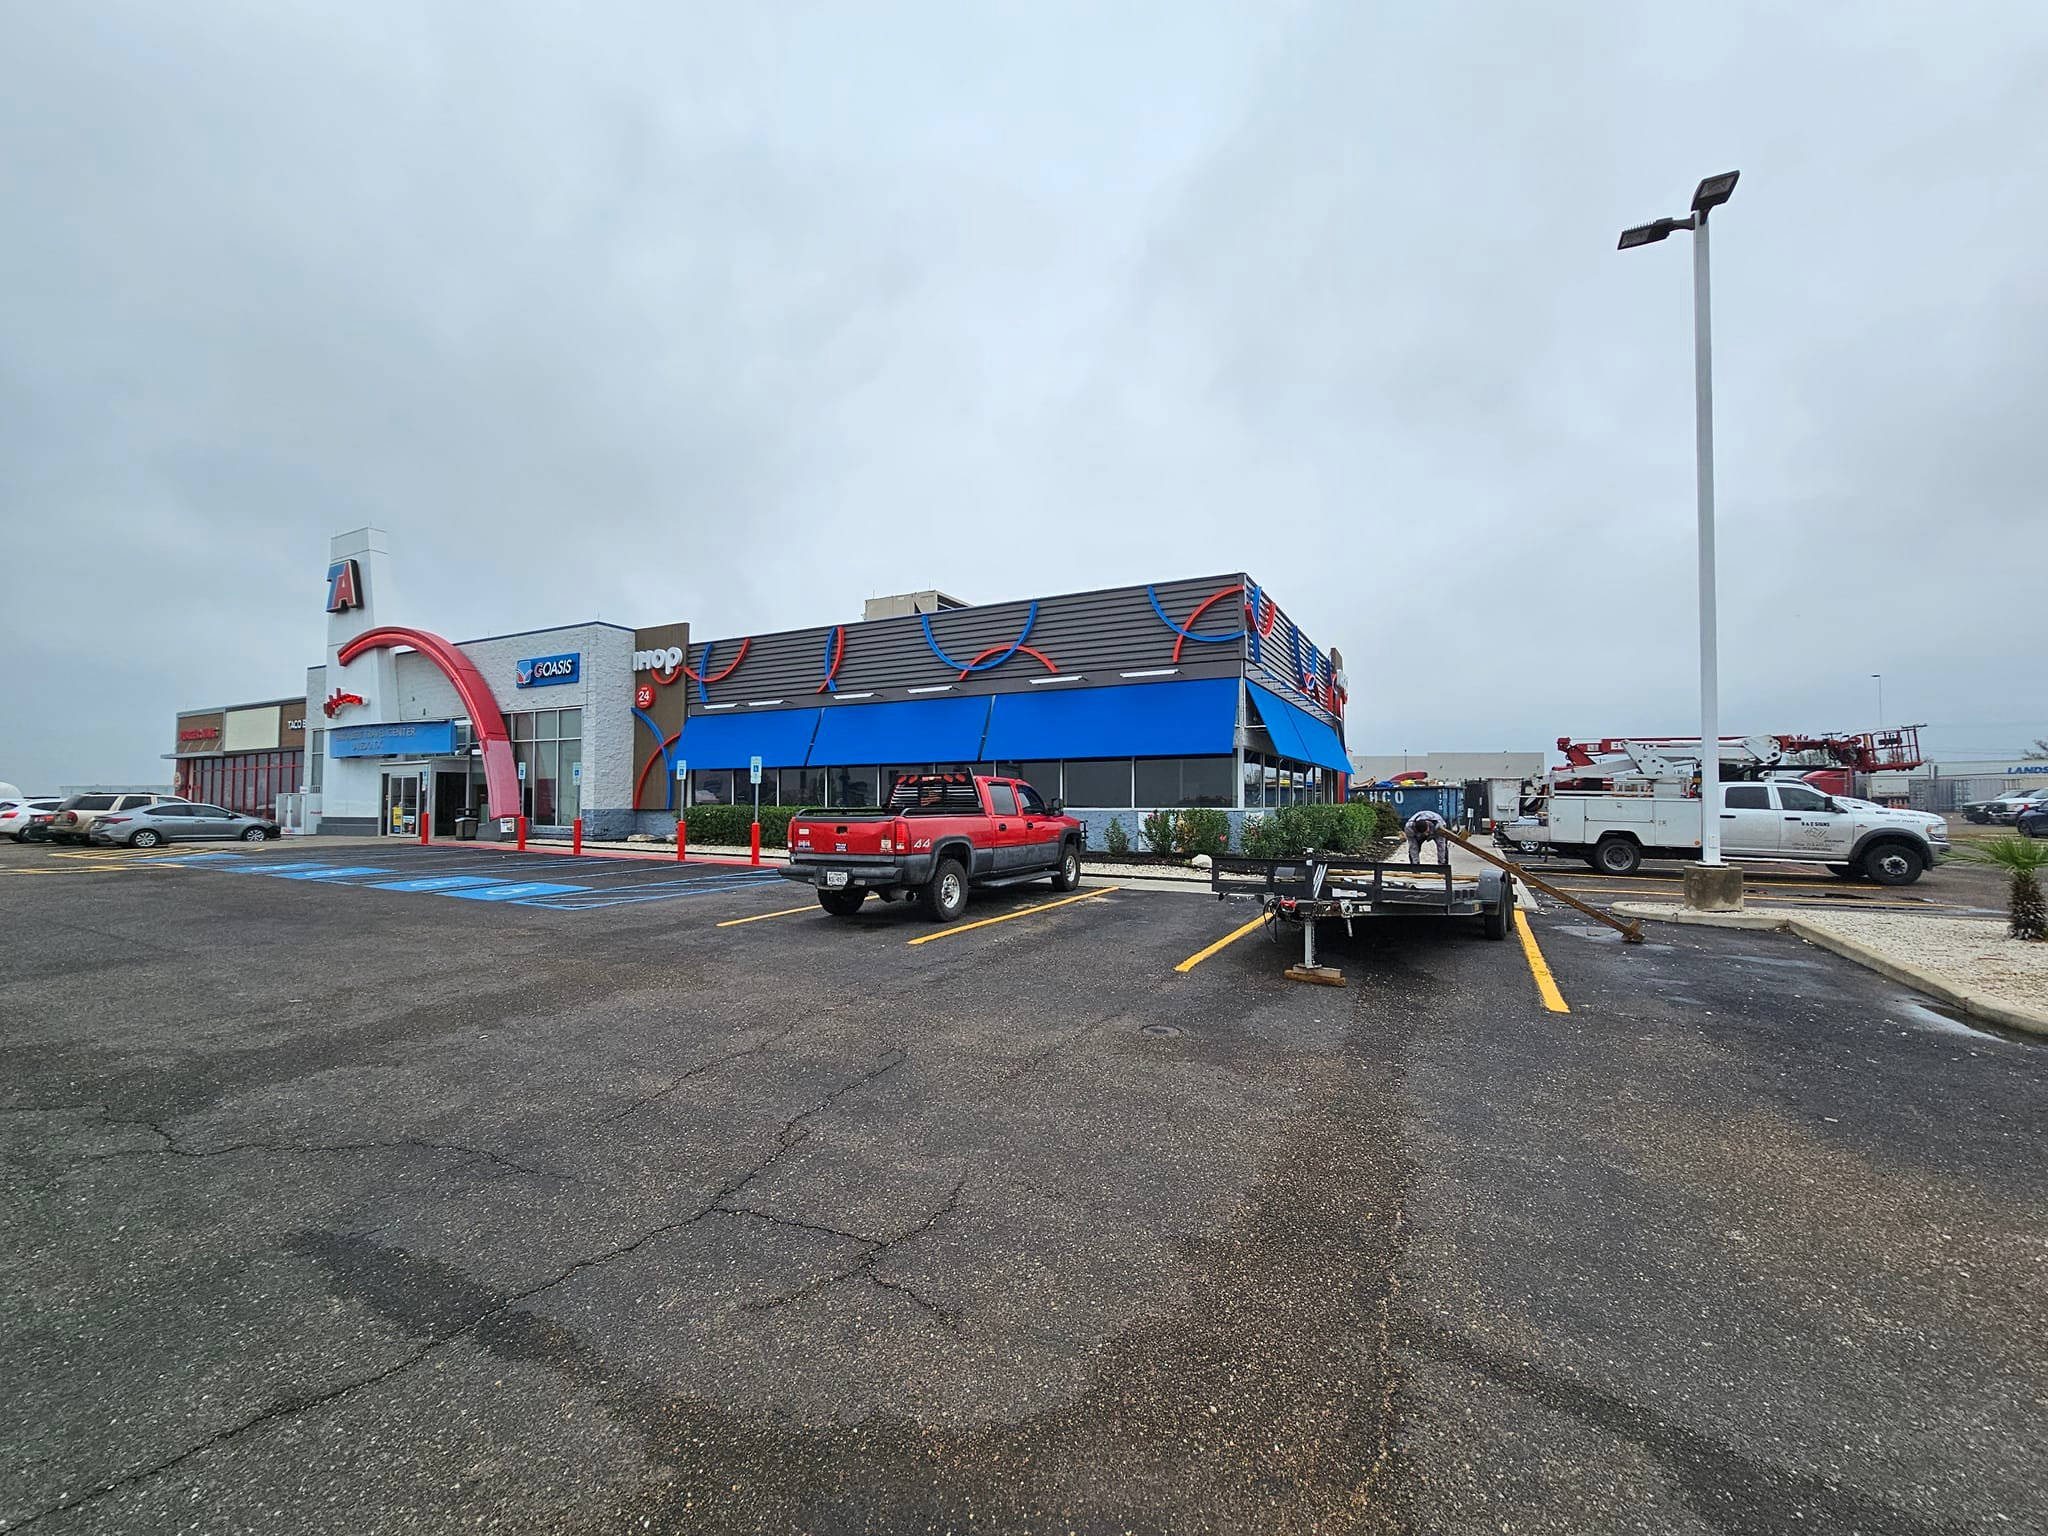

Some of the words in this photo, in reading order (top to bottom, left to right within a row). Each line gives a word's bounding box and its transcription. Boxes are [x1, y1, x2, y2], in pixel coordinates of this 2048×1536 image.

[326, 560, 362, 612] TA
[534, 659, 573, 678] GOASIS
[638, 690, 650, 701] 24
[287, 720, 302, 730] TACO
[387, 727, 416, 736] CENTER
